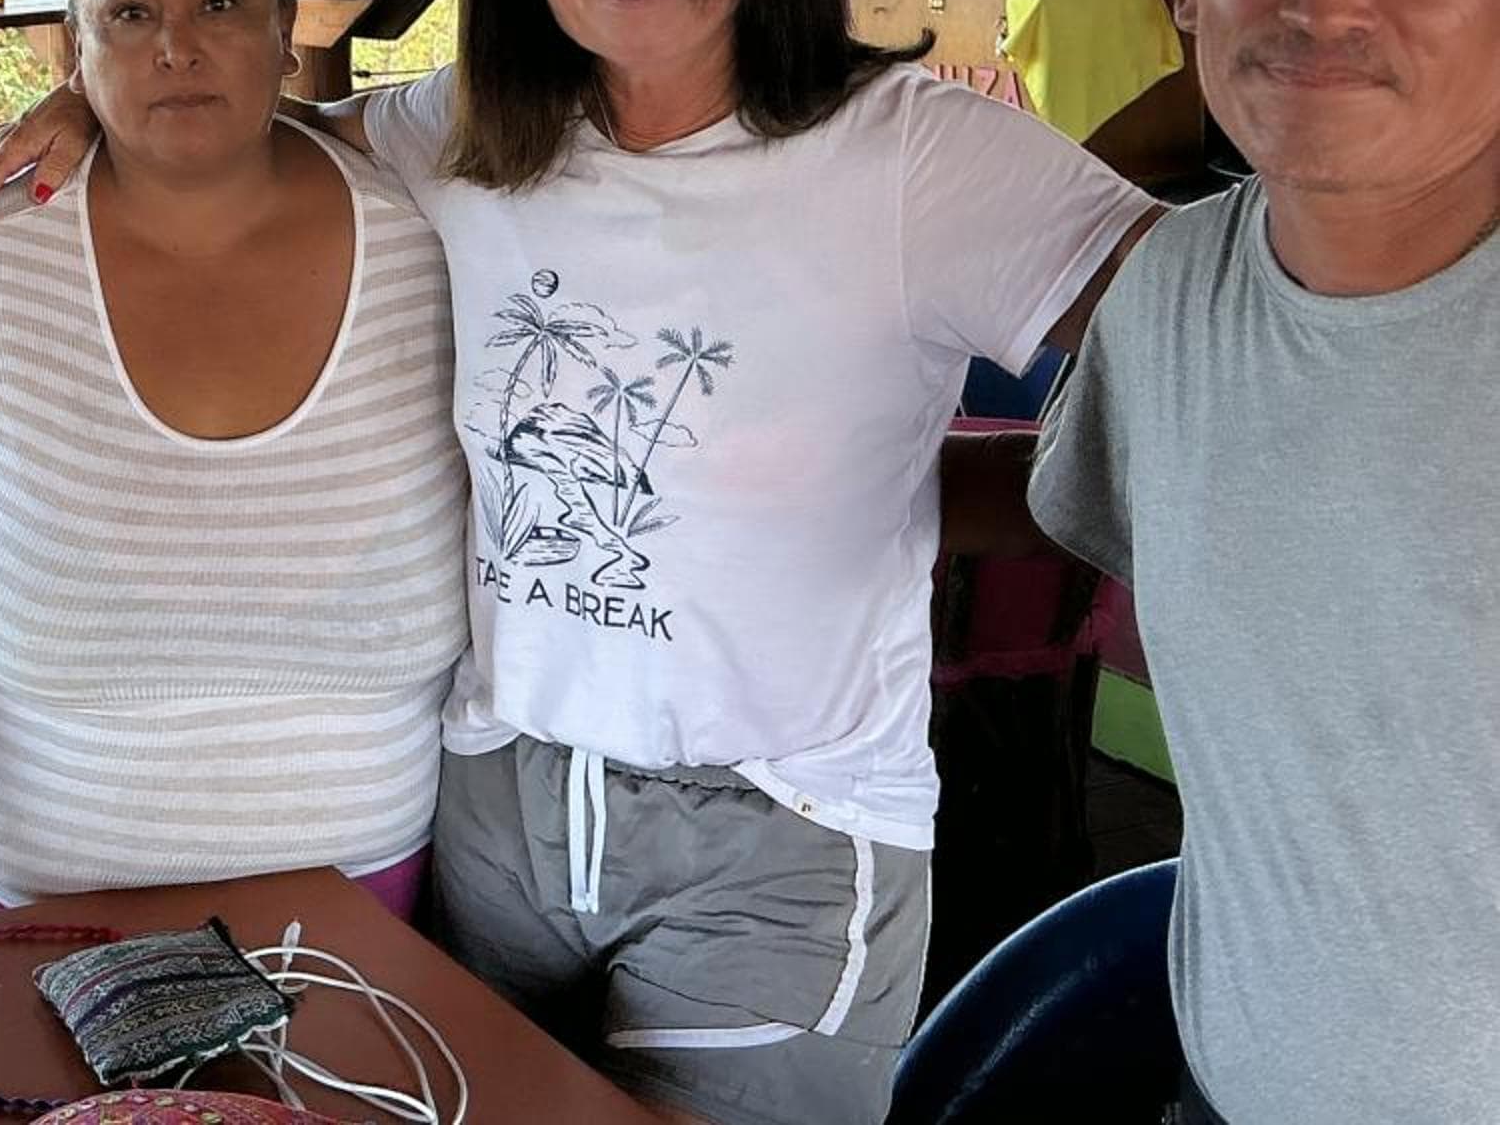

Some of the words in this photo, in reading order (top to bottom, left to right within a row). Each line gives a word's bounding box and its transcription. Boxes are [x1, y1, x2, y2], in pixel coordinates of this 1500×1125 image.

[476, 557, 512, 603] TAE
[525, 578, 554, 608] A
[565, 583, 673, 642] BREAK
